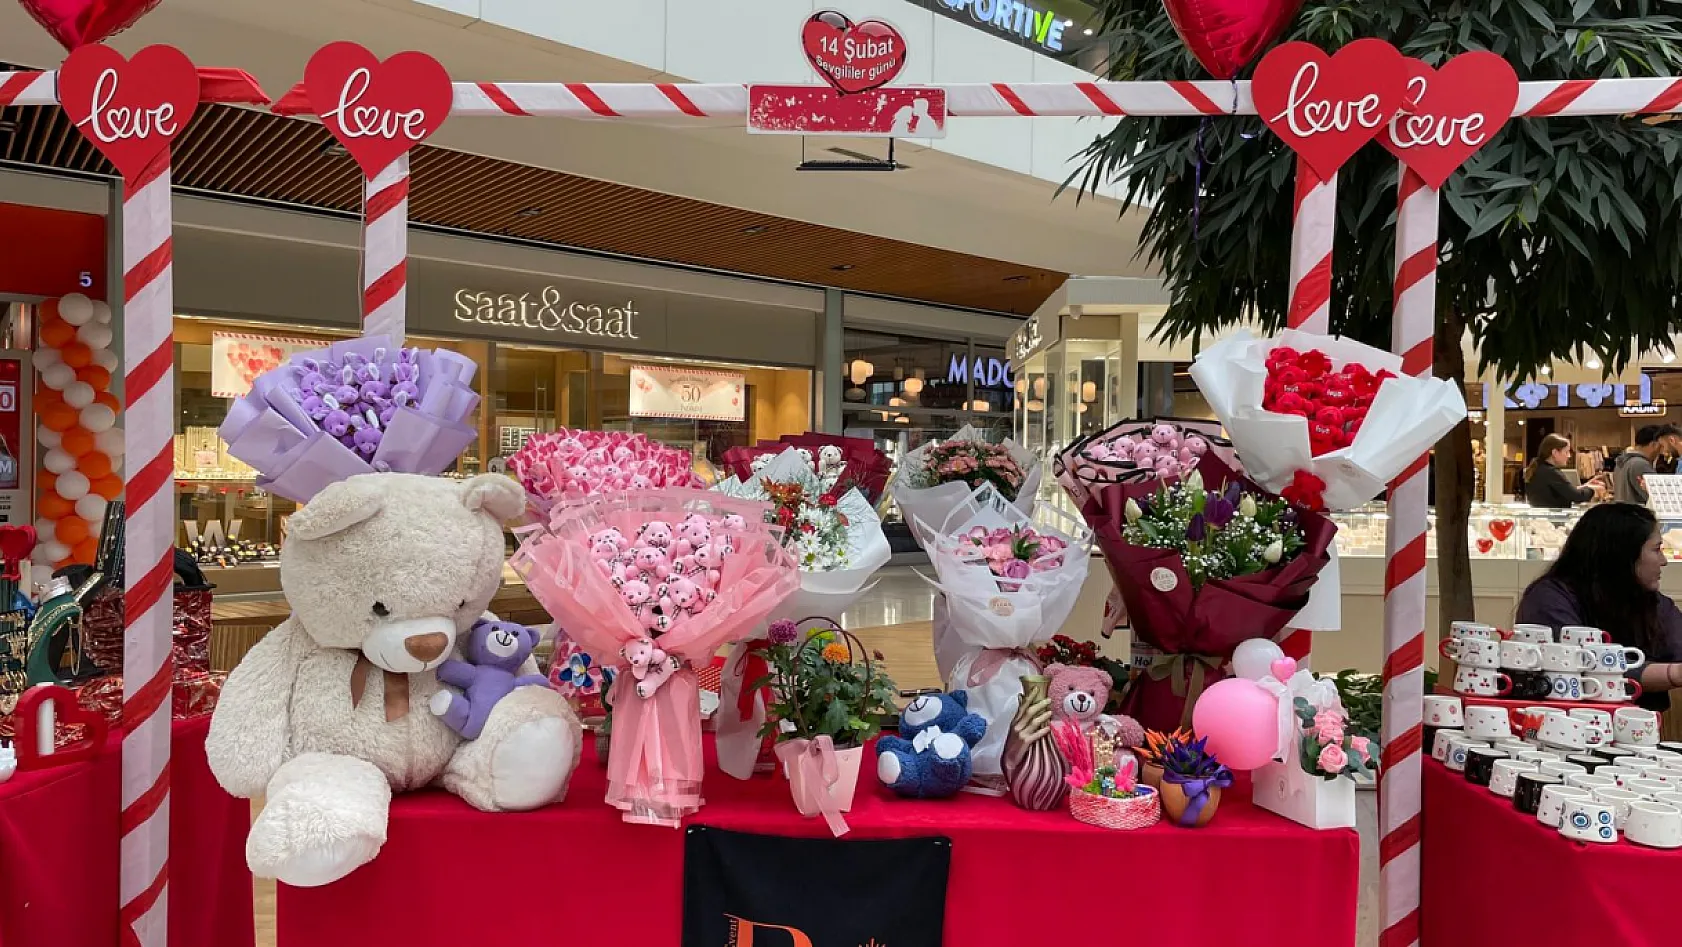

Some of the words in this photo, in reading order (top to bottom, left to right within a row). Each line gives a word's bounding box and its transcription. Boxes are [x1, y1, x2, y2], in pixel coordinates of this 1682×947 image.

[820, 36, 838, 56] 14
[843, 37, 894, 63] Şubat
[938, 0, 1064, 52] ORTIVE
[815, 55, 867, 80] Sevgililer
[868, 58, 896, 80] günü
[75, 68, 178, 143] love
[320, 67, 427, 140] love
[1269, 61, 1383, 137] love
[79, 271, 92, 287] 5
[455, 286, 640, 339] saat&saat
[728, 918, 738, 947] vent
